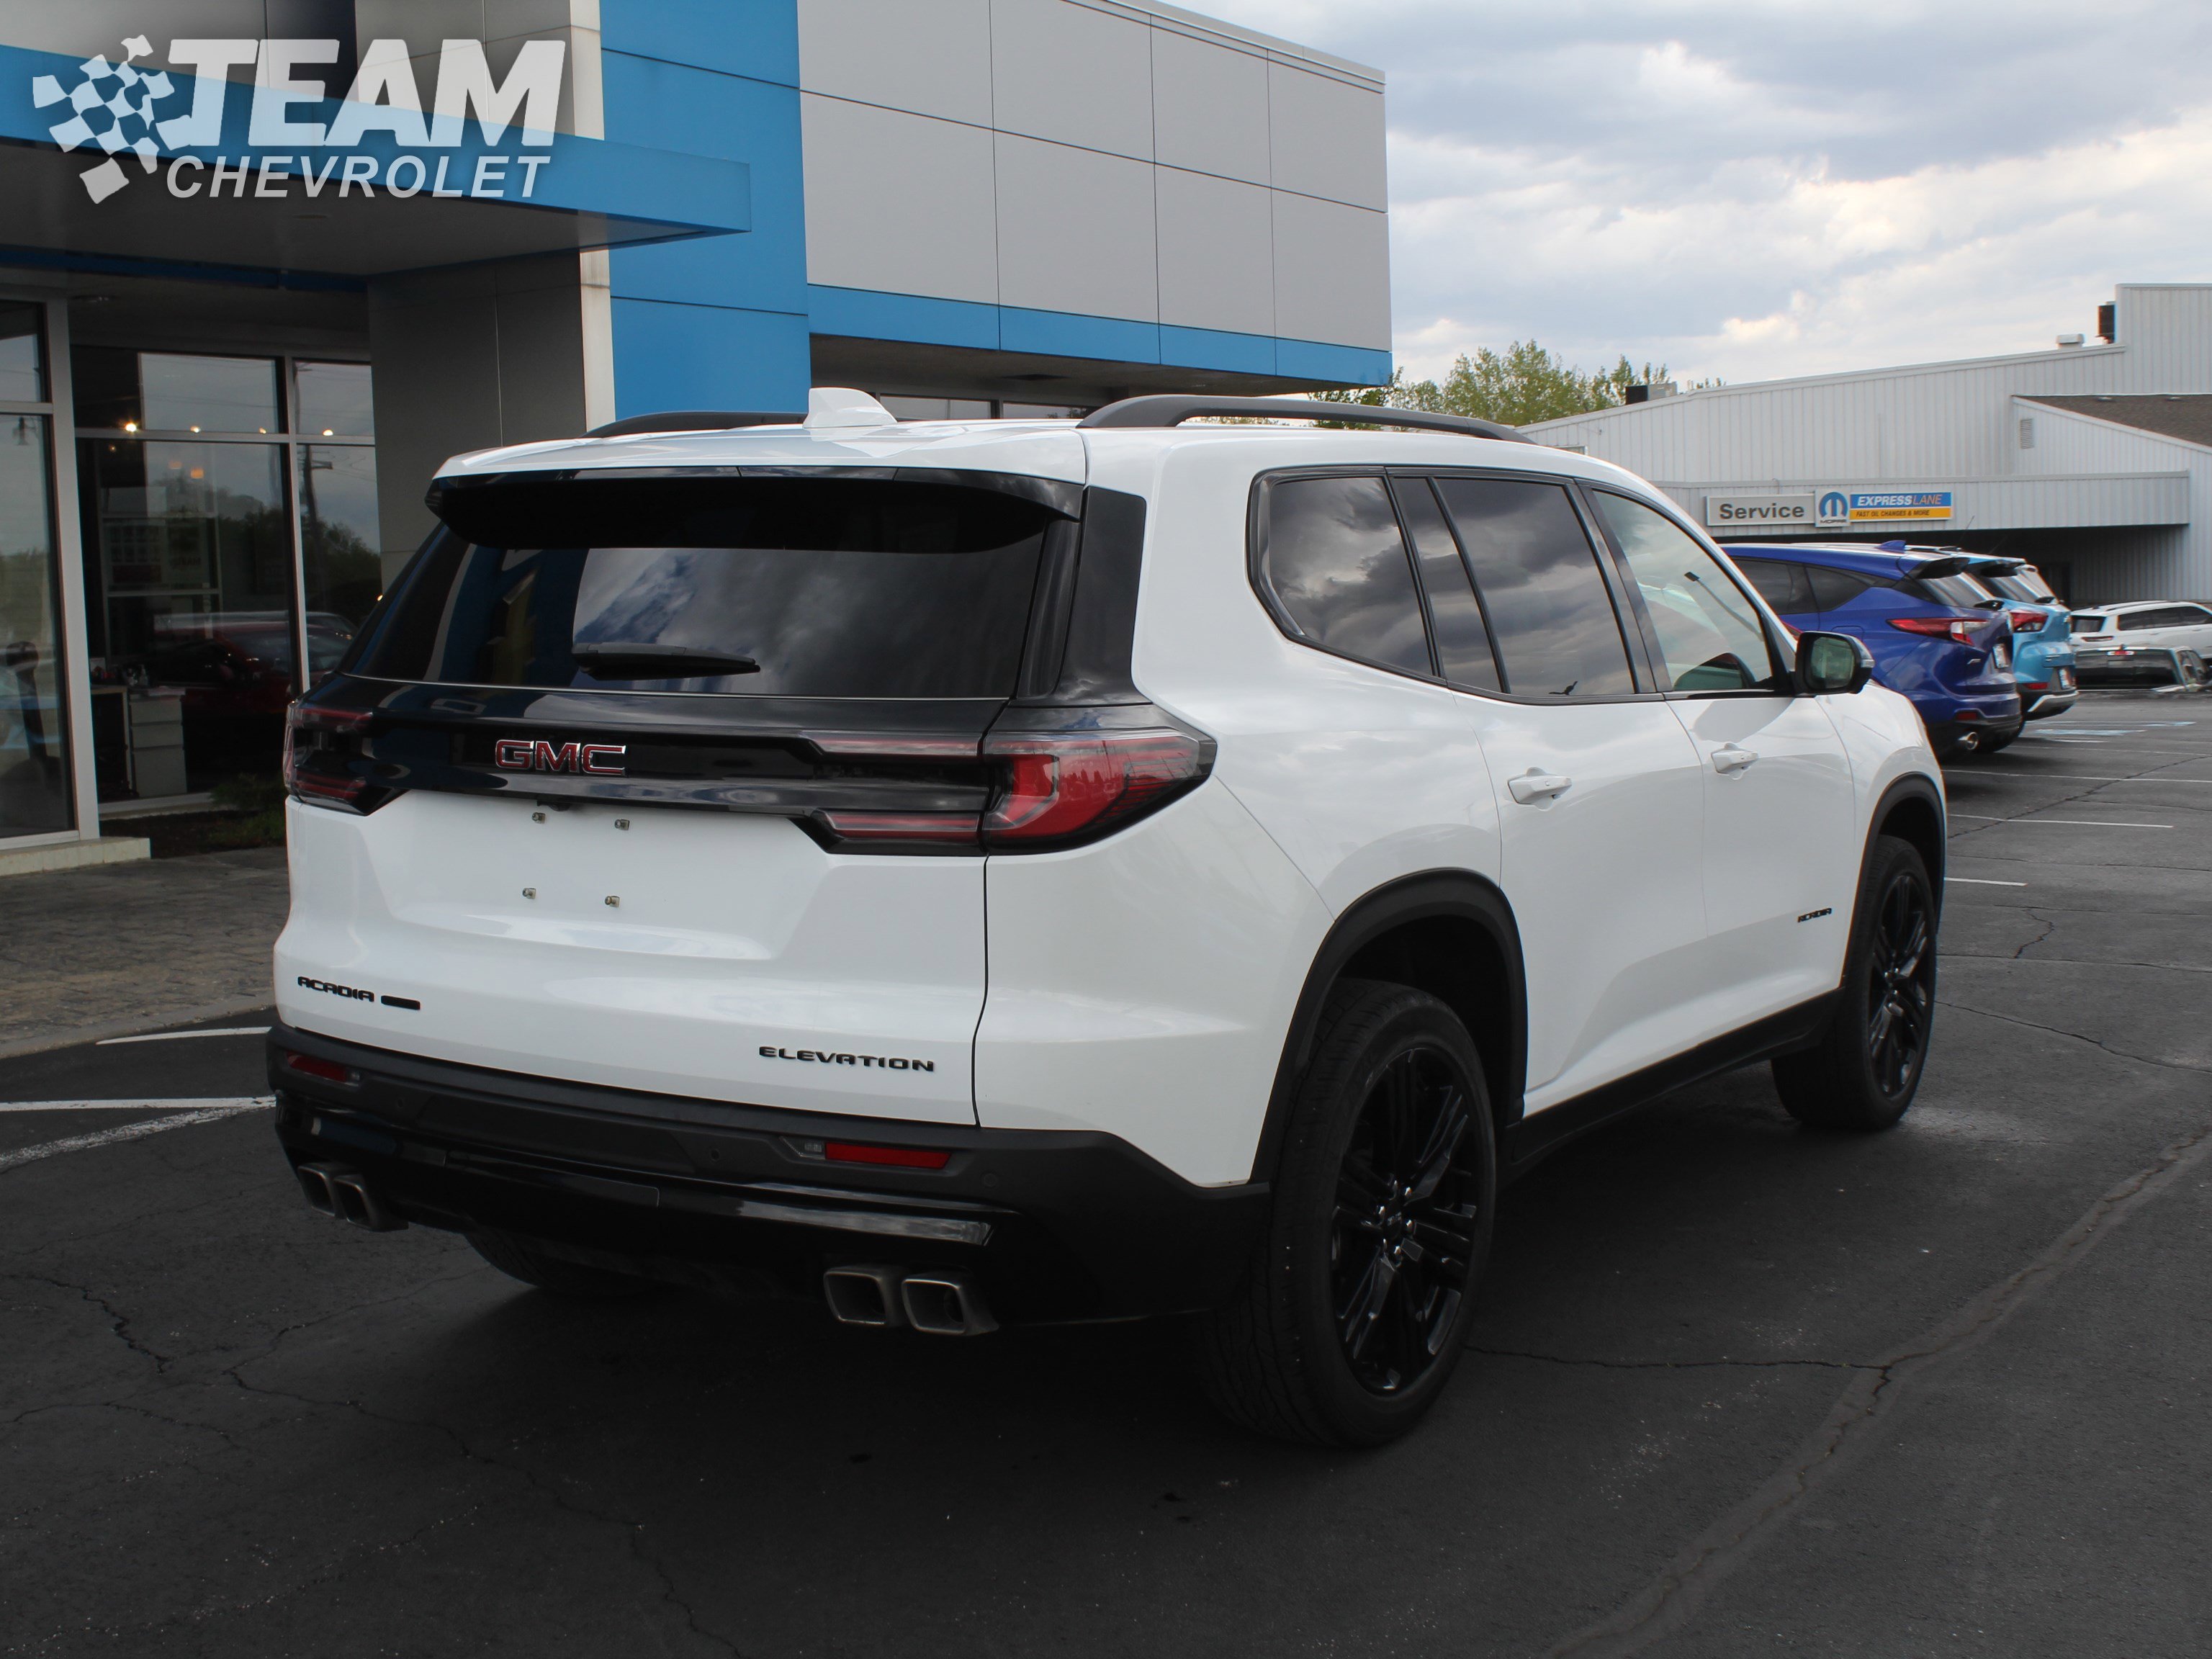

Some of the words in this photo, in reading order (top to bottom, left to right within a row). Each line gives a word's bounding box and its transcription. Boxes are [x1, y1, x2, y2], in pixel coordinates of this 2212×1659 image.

[1719, 503, 1804, 519] Service
[495, 739, 626, 776] GMC
[297, 976, 374, 1002] ACADIA
[759, 1046, 935, 1072] ELEVATION
